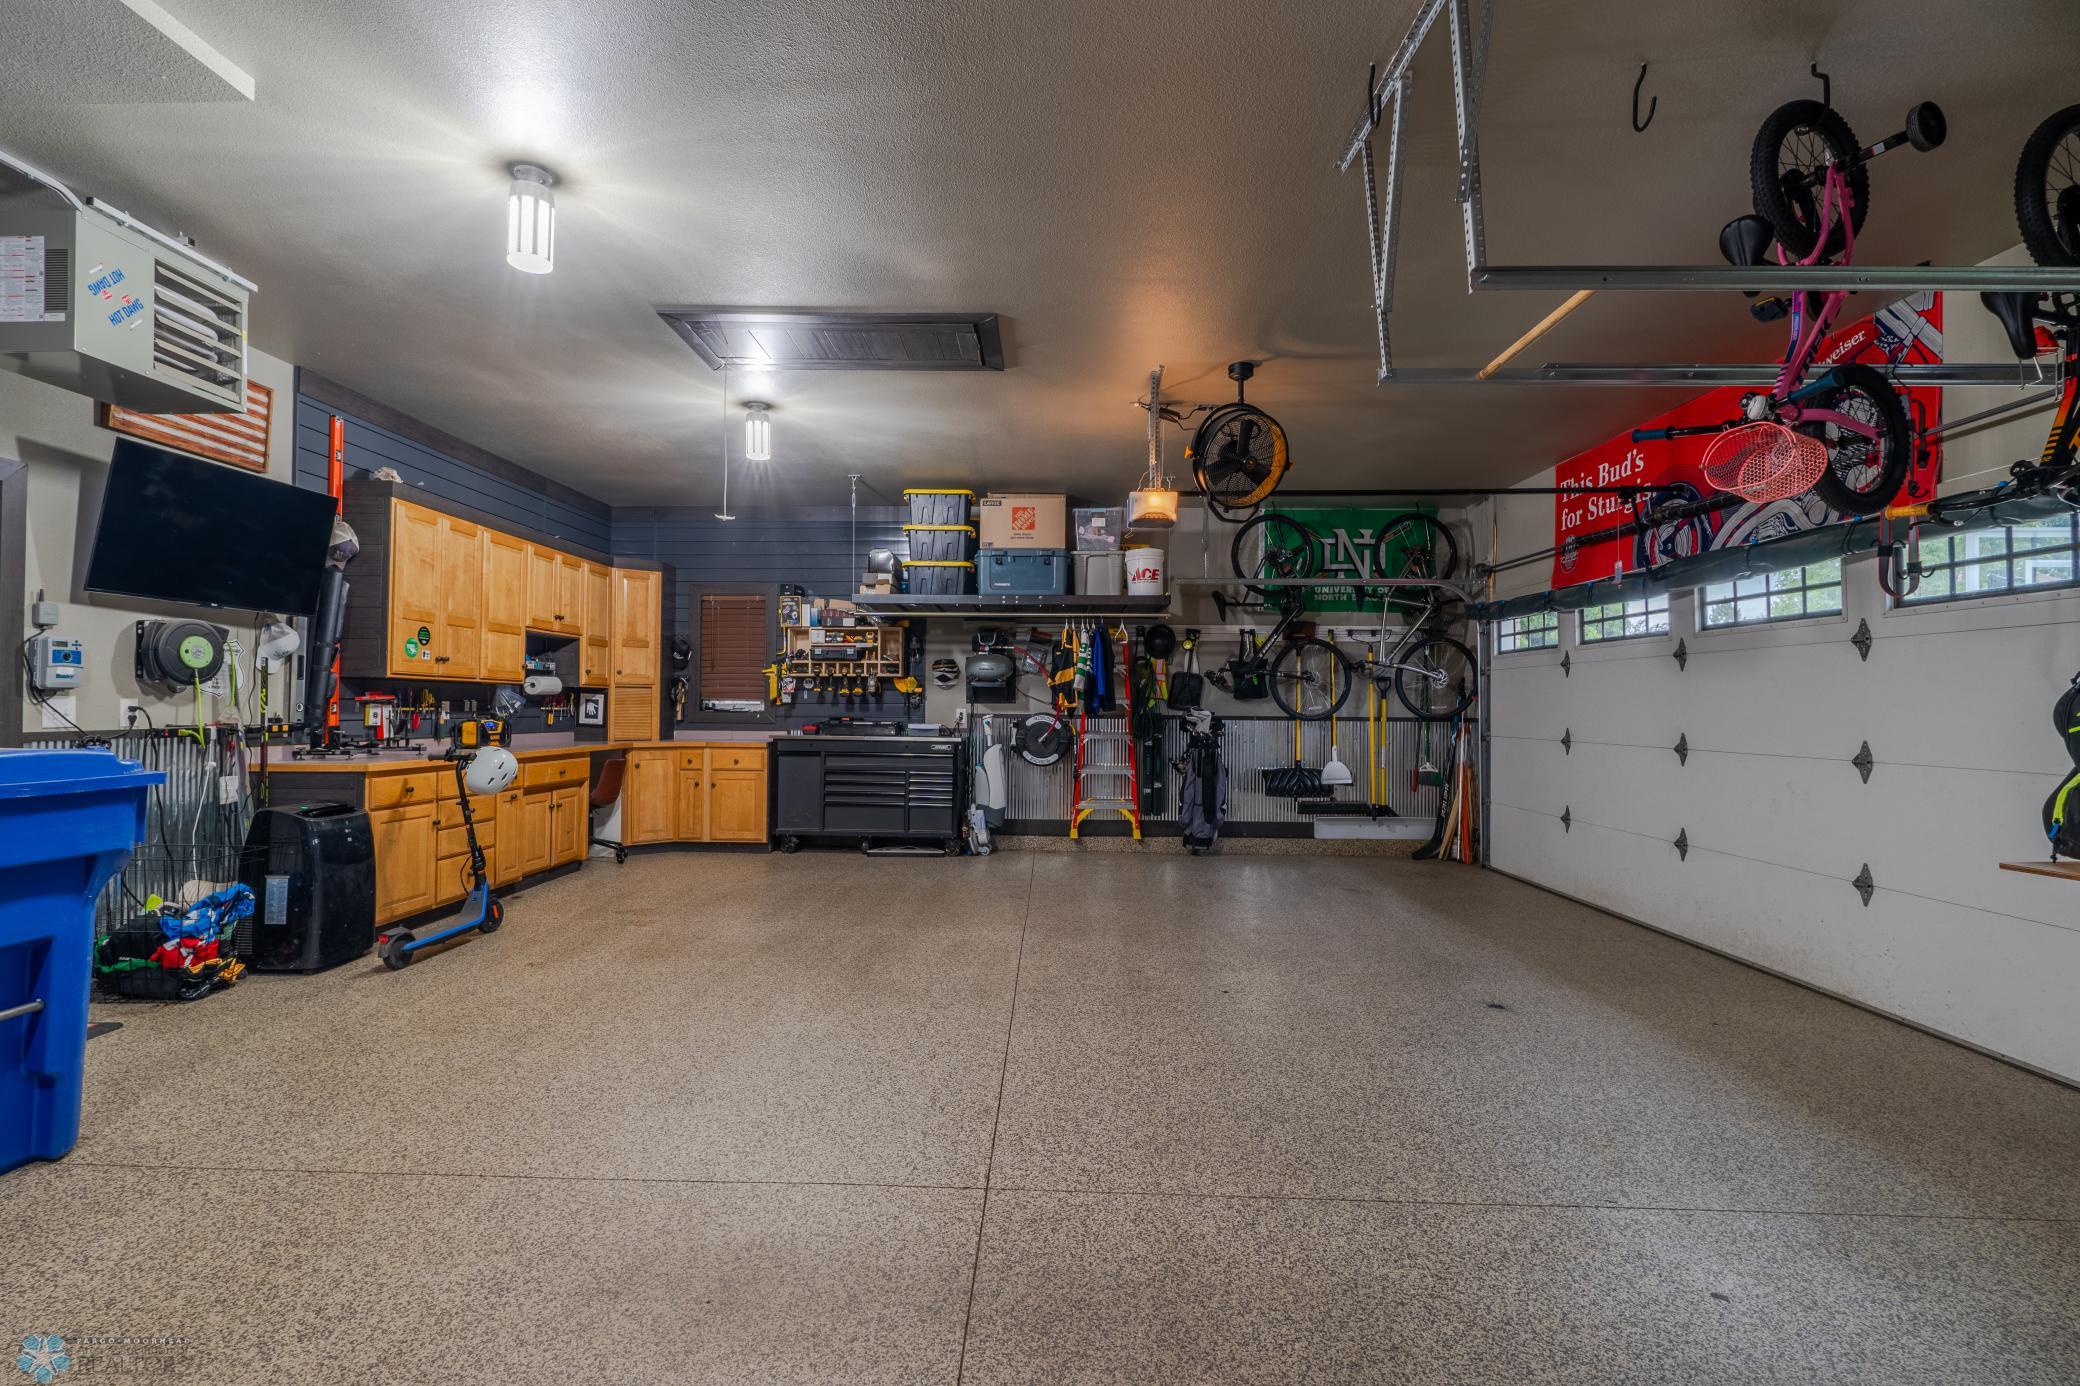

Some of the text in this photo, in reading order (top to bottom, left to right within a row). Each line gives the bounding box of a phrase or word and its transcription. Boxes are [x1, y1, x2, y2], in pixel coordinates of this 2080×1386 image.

[88, 276, 111, 296] DAWG
[109, 268, 125, 285] HOT
[108, 308, 124, 326] HOT
[122, 298, 144, 318] DAWG
[1598, 448, 1644, 488] Bud's
[1561, 508, 1583, 531] for
[1132, 567, 1159, 582] ACE
